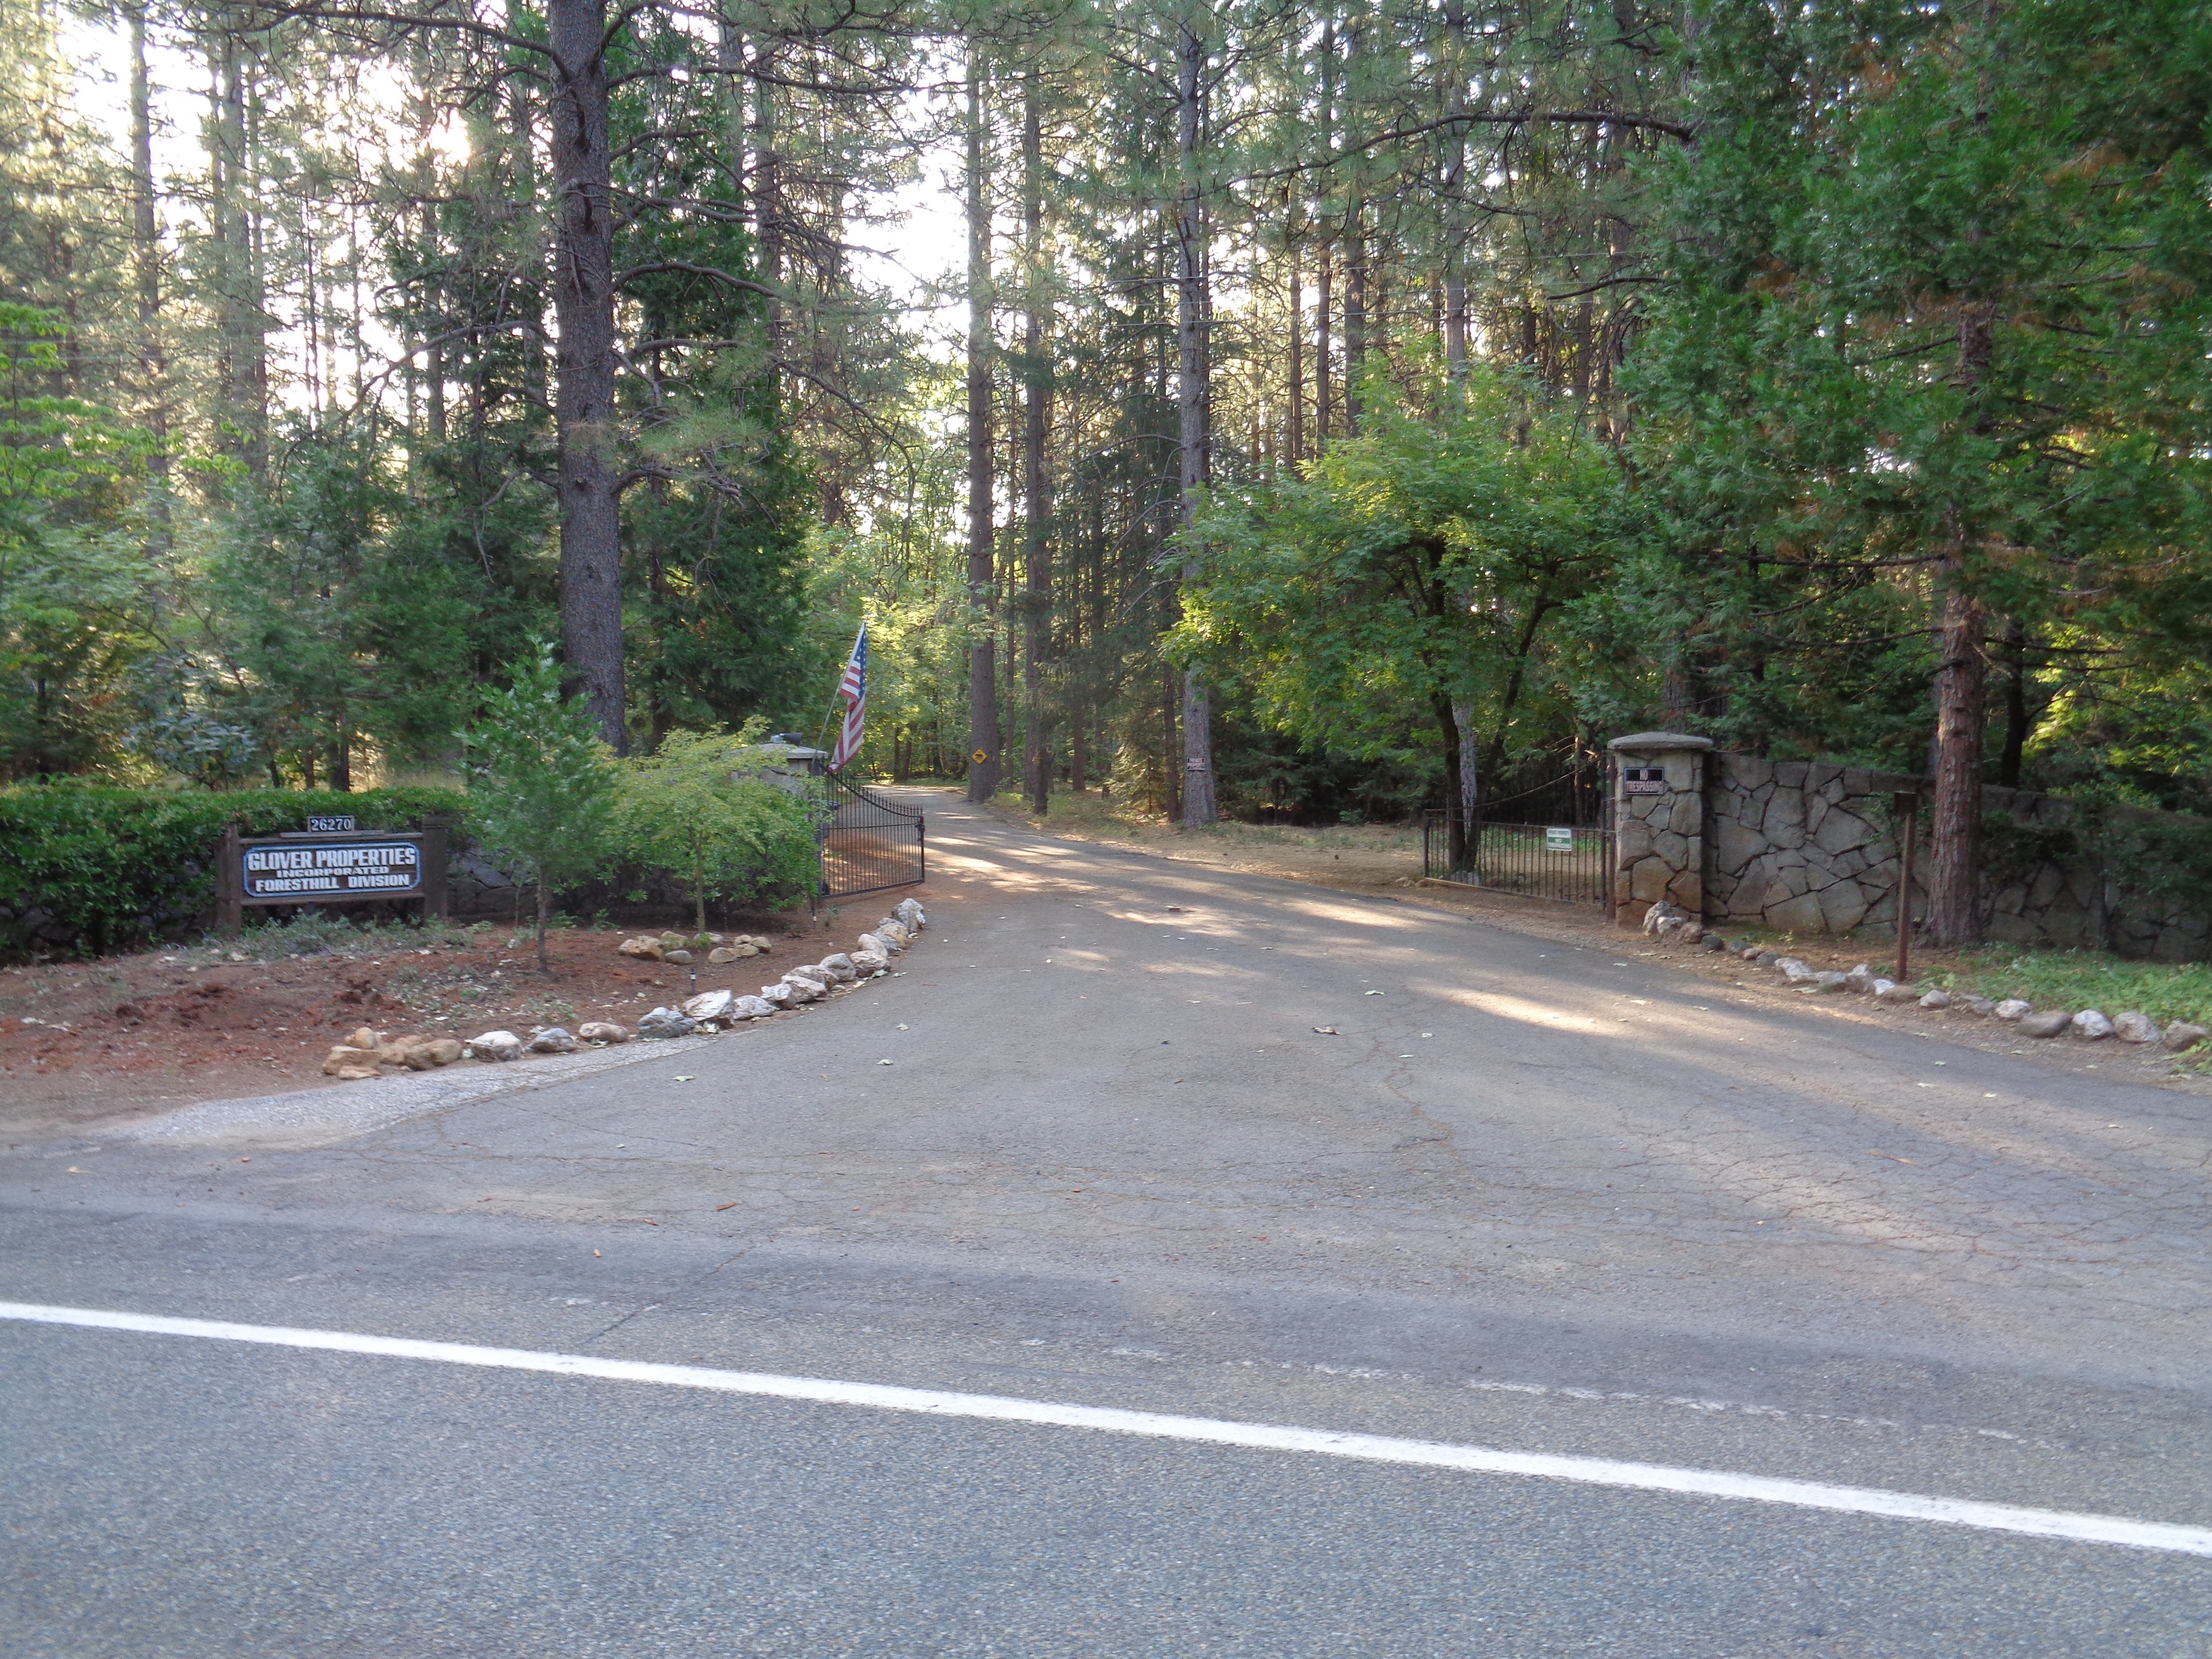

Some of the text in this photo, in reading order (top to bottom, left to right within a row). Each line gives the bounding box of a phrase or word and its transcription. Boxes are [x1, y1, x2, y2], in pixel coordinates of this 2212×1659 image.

[1639, 769, 1648, 780] NO
[311, 818, 351, 831] 26270
[248, 848, 415, 871] GLOVER PROPERTIES
[276, 866, 390, 878] INCORPORATED
[255, 874, 410, 892] FORESTHILL DIVISION
